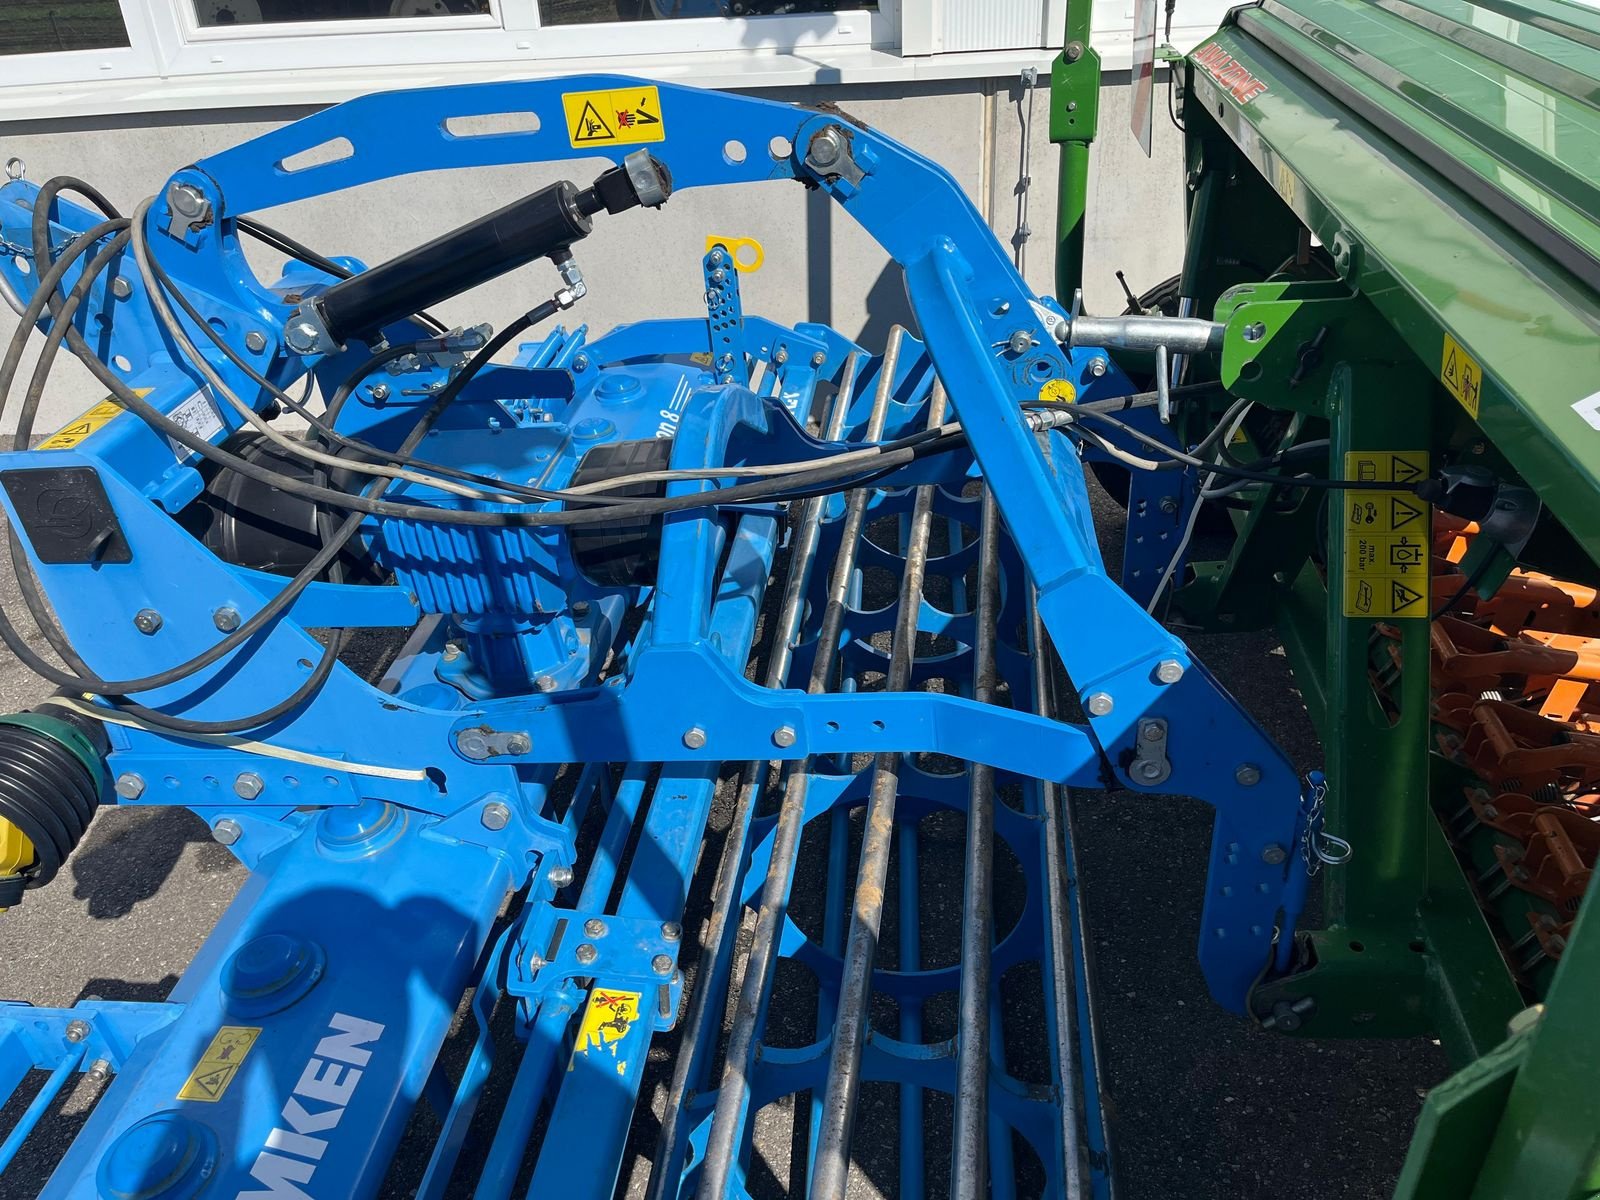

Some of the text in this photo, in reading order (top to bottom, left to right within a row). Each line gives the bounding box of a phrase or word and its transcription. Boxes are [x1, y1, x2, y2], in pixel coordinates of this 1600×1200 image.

[1188, 41, 1268, 105] AMAZONE
[660, 409, 679, 423] 8
[1359, 539, 1367, 571] 200 bar
